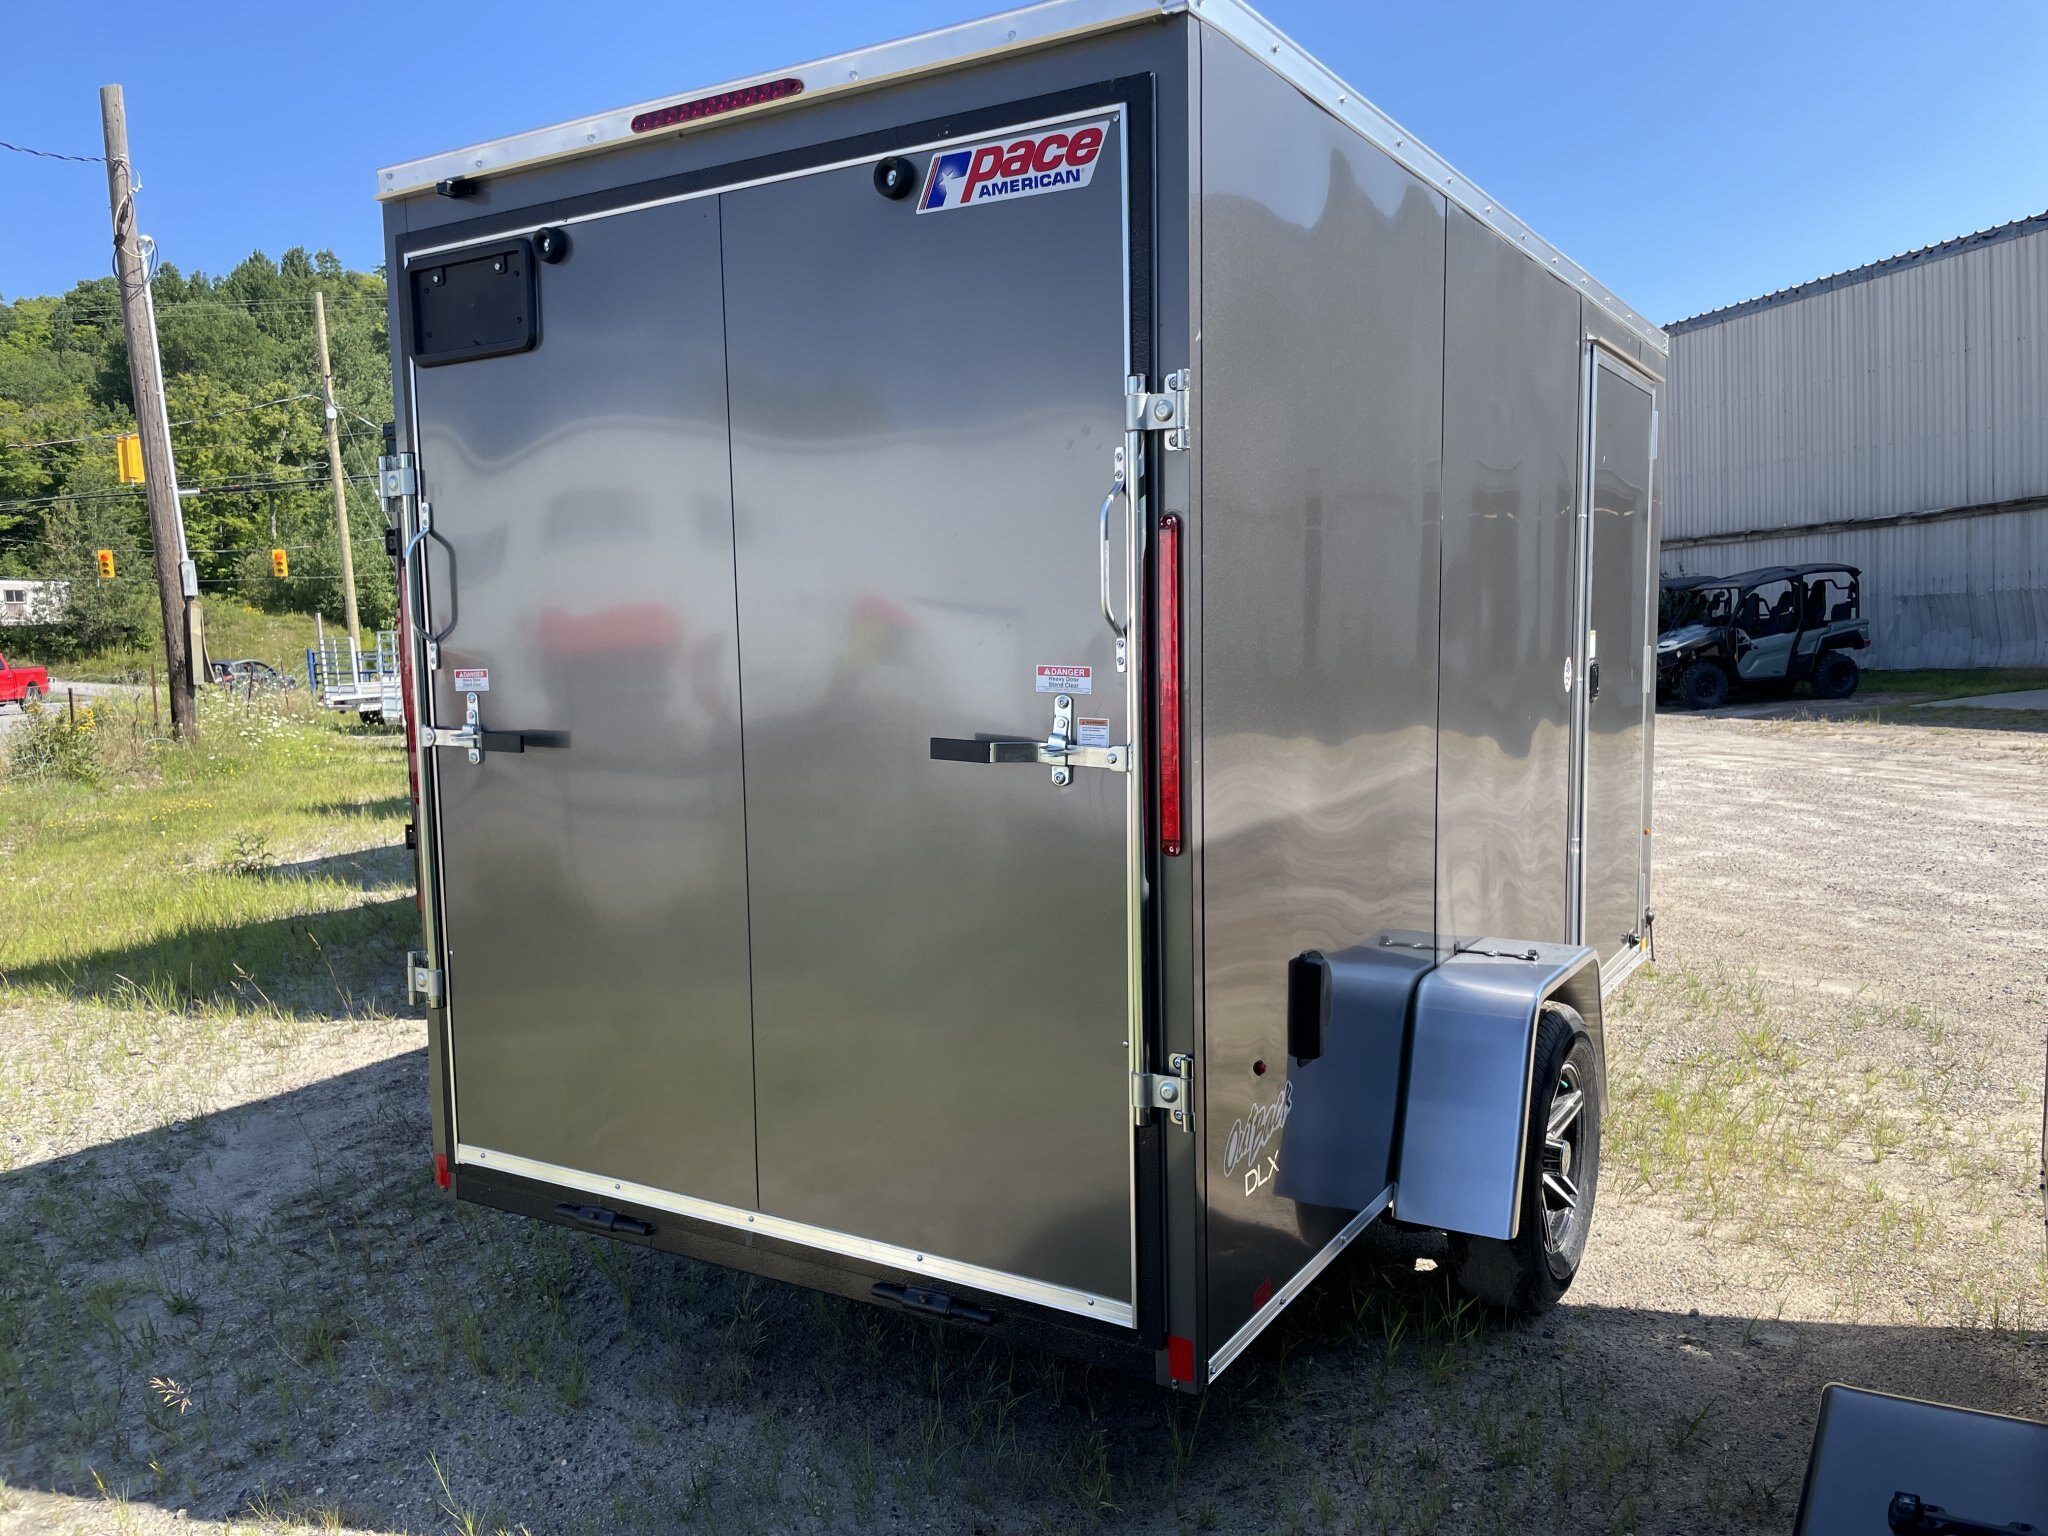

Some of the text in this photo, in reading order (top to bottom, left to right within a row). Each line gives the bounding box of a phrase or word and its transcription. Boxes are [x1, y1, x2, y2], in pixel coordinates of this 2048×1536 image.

[960, 127, 1103, 204] pace
[978, 168, 1081, 199] AMERICAN
[1051, 667, 1085, 677] DANGER
[1244, 1149, 1280, 1198] DLX
